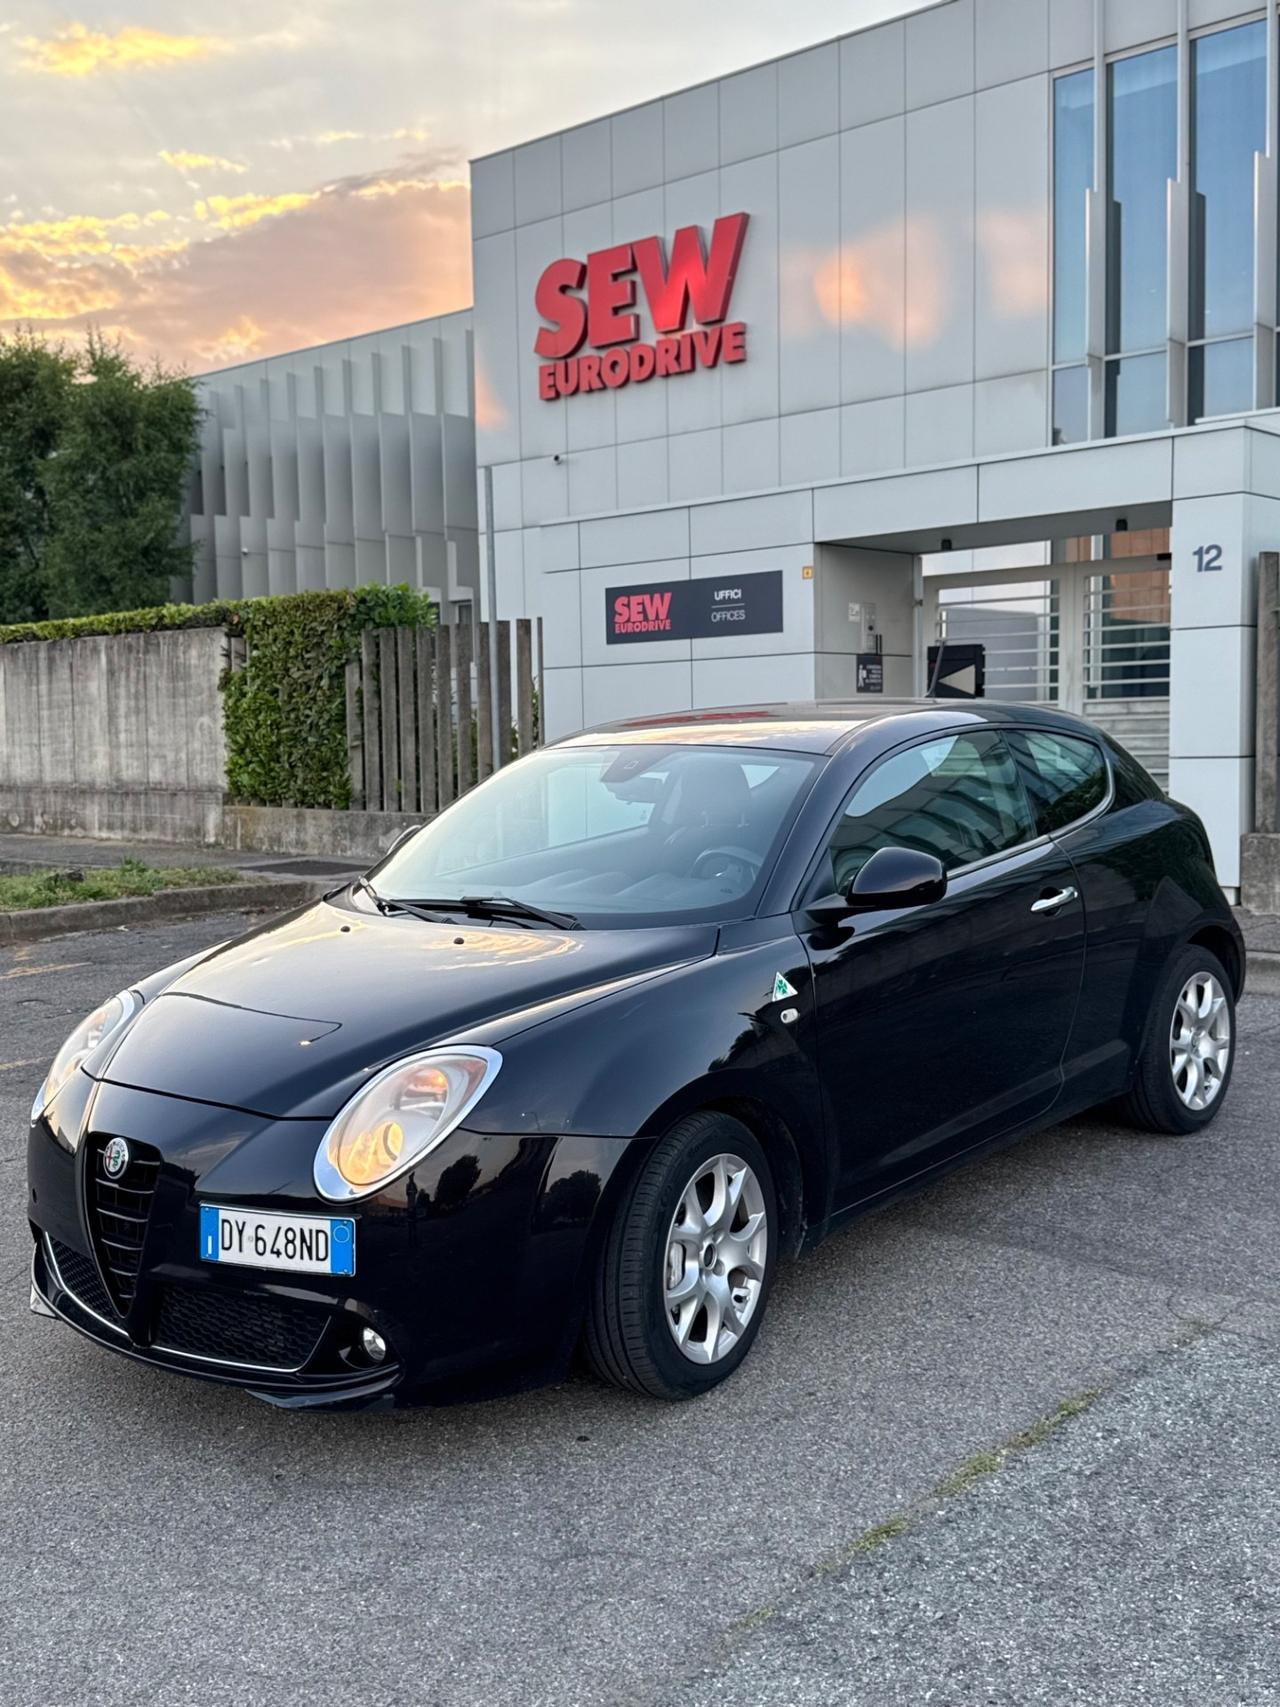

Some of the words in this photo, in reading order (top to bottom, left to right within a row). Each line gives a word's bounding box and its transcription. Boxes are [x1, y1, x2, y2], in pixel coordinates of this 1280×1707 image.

[534, 211, 750, 359] SEW
[539, 321, 747, 402] EURODRIVE
[1192, 544, 1222, 572] 12
[614, 592, 672, 622] SEW
[714, 588, 742, 601] UFFICI
[615, 619, 671, 633] EURODRIVE
[711, 610, 746, 622] OFFICES
